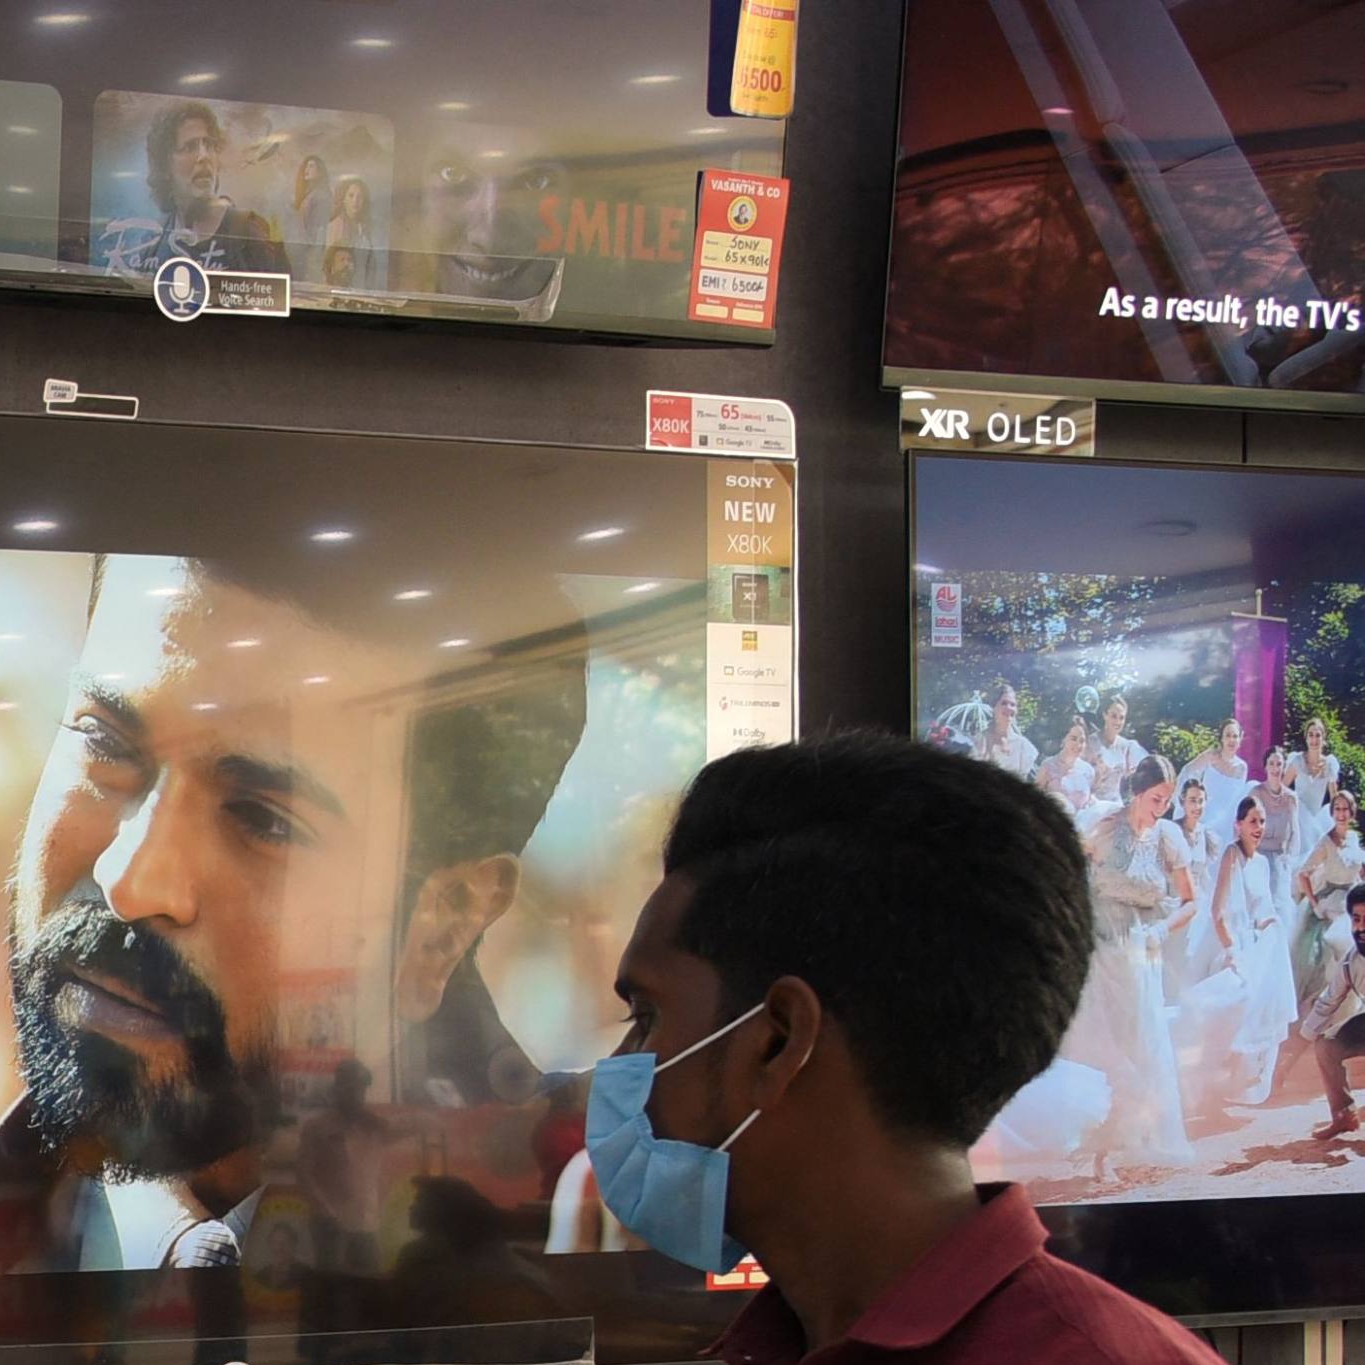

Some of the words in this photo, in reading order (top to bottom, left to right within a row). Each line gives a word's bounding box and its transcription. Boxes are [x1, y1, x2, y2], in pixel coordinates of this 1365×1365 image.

[712, 180, 756, 195] VASANTH
[757, 186, 764, 196] &
[767, 187, 780, 198] CO
[537, 195, 687, 263] SMILE
[221, 281, 273, 294] Hands-free
[218, 292, 243, 307] Voice
[245, 295, 274, 307] Search
[1099, 287, 1136, 318] As
[1142, 296, 1159, 319] a
[1165, 294, 1249, 329] result,
[1255, 297, 1300, 327] the
[1305, 300, 1360, 332] TV's
[653, 418, 689, 434] X80K
[918, 408, 970, 440] XR
[987, 412, 1076, 446] OLED
[725, 475, 774, 488] SONY
[725, 501, 776, 523] NEW
[727, 534, 772, 554] X80K
[737, 668, 765, 678] Google
